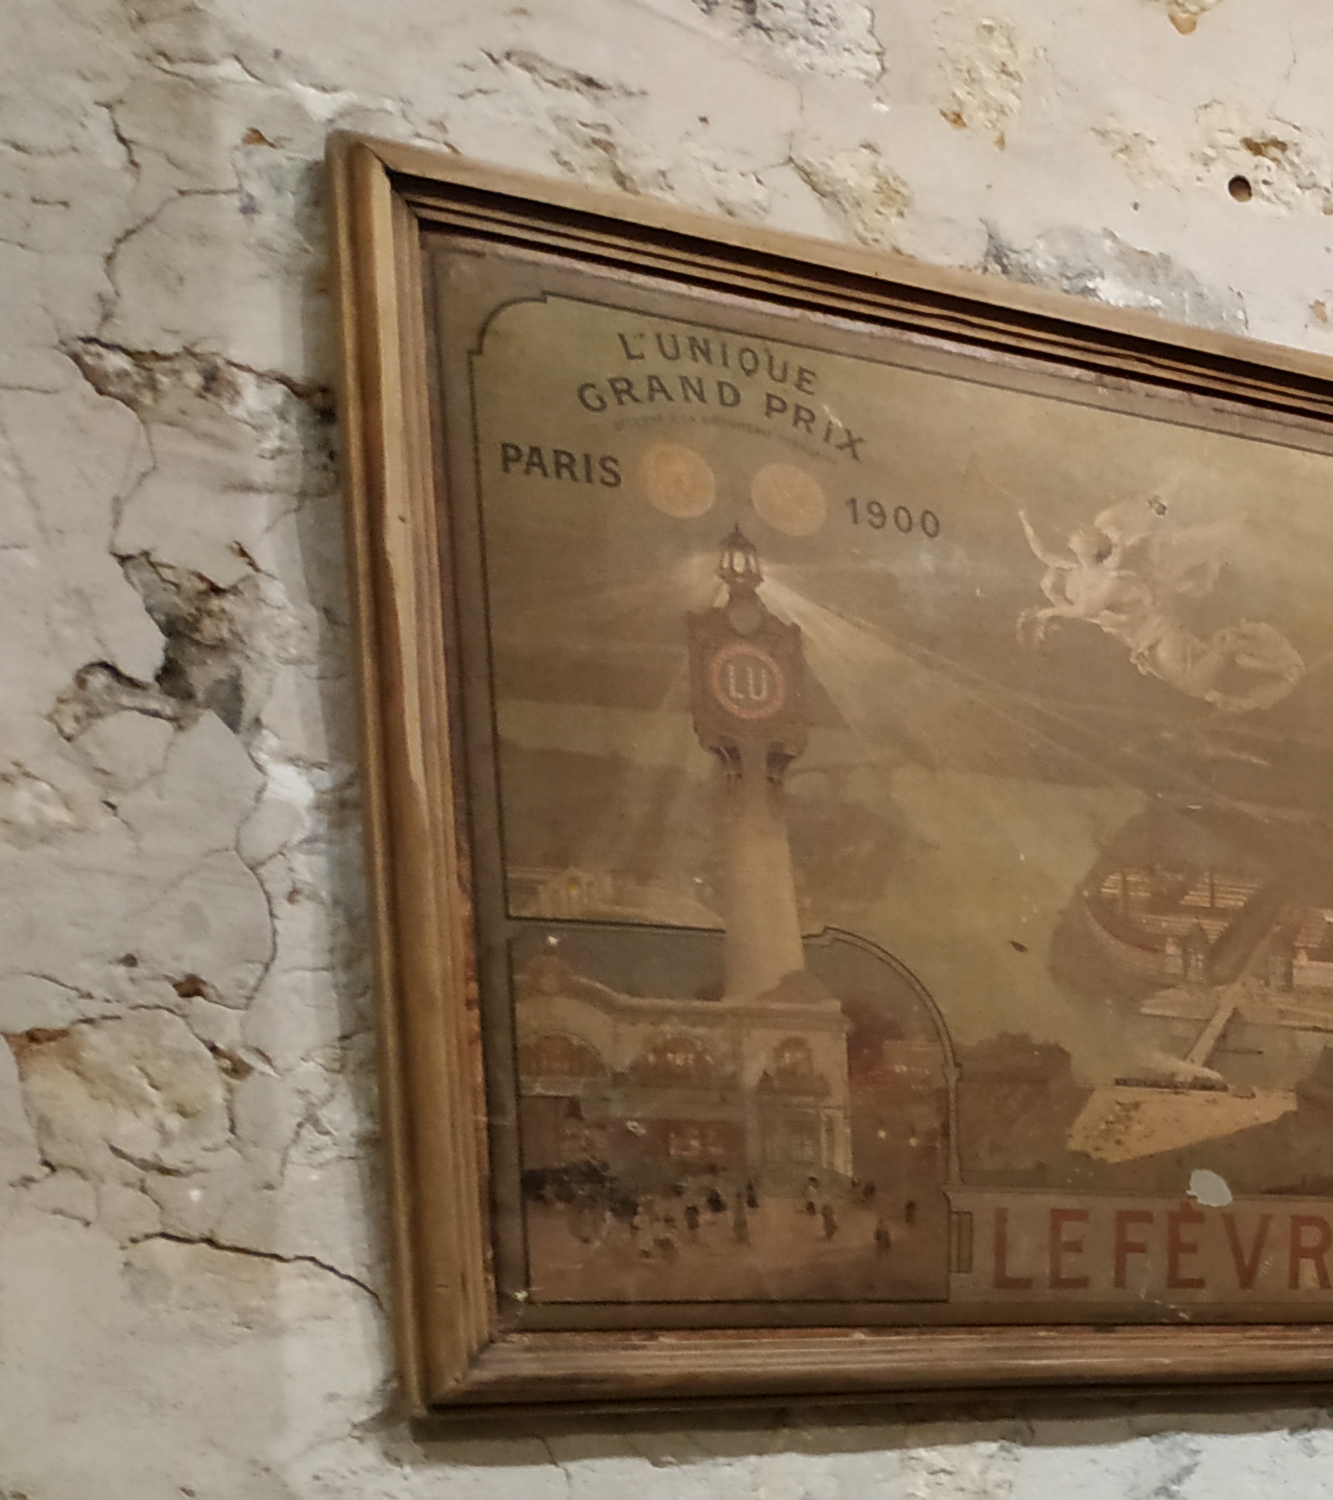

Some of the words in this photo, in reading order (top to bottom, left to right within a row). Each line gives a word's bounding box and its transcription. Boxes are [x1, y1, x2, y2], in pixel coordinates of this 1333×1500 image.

[617, 330, 819, 397] L'UNIQUE
[577, 373, 743, 414] GRAND
[764, 392, 868, 462] PRIX
[500, 441, 622, 489] PARIS
[843, 497, 942, 540] 1900
[725, 661, 769, 702] LU
